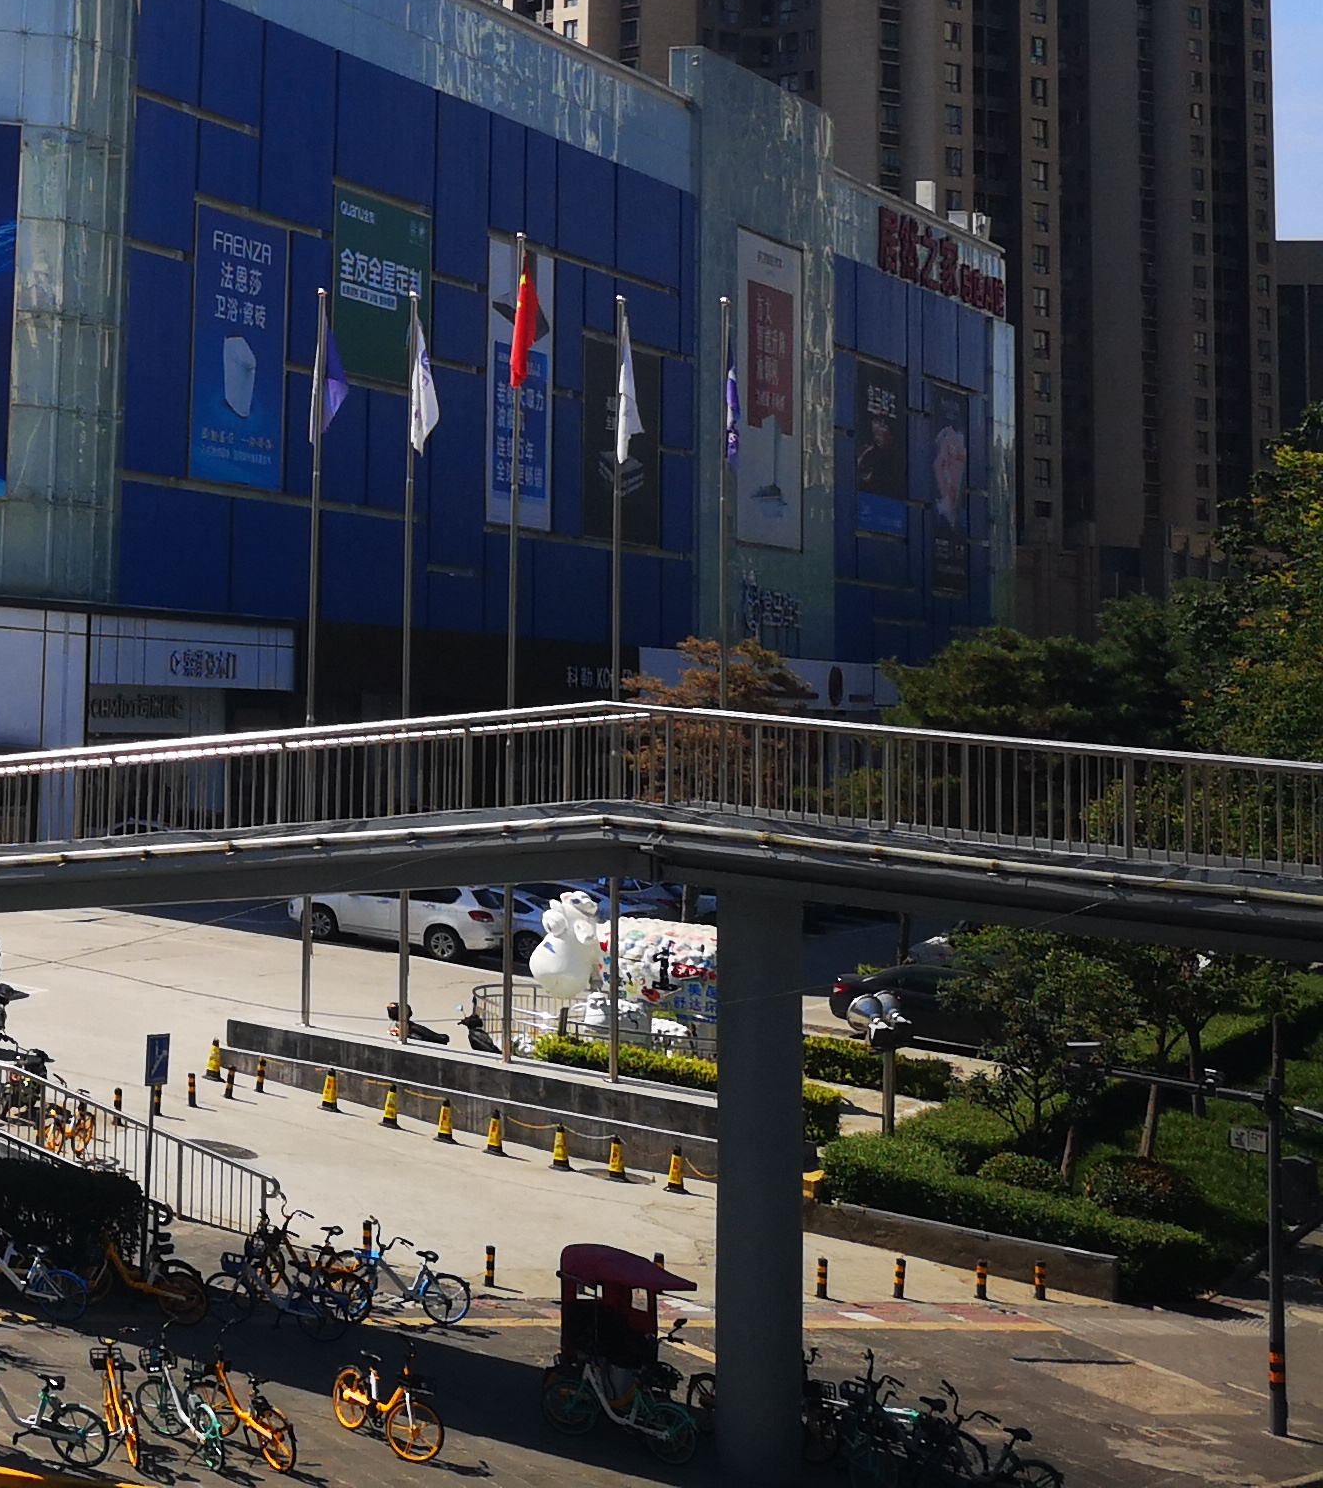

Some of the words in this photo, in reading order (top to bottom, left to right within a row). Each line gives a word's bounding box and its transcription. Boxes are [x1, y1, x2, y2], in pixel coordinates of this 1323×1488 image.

[213, 230, 272, 265] FAENZA
[220, 261, 262, 295] 法恩莎
